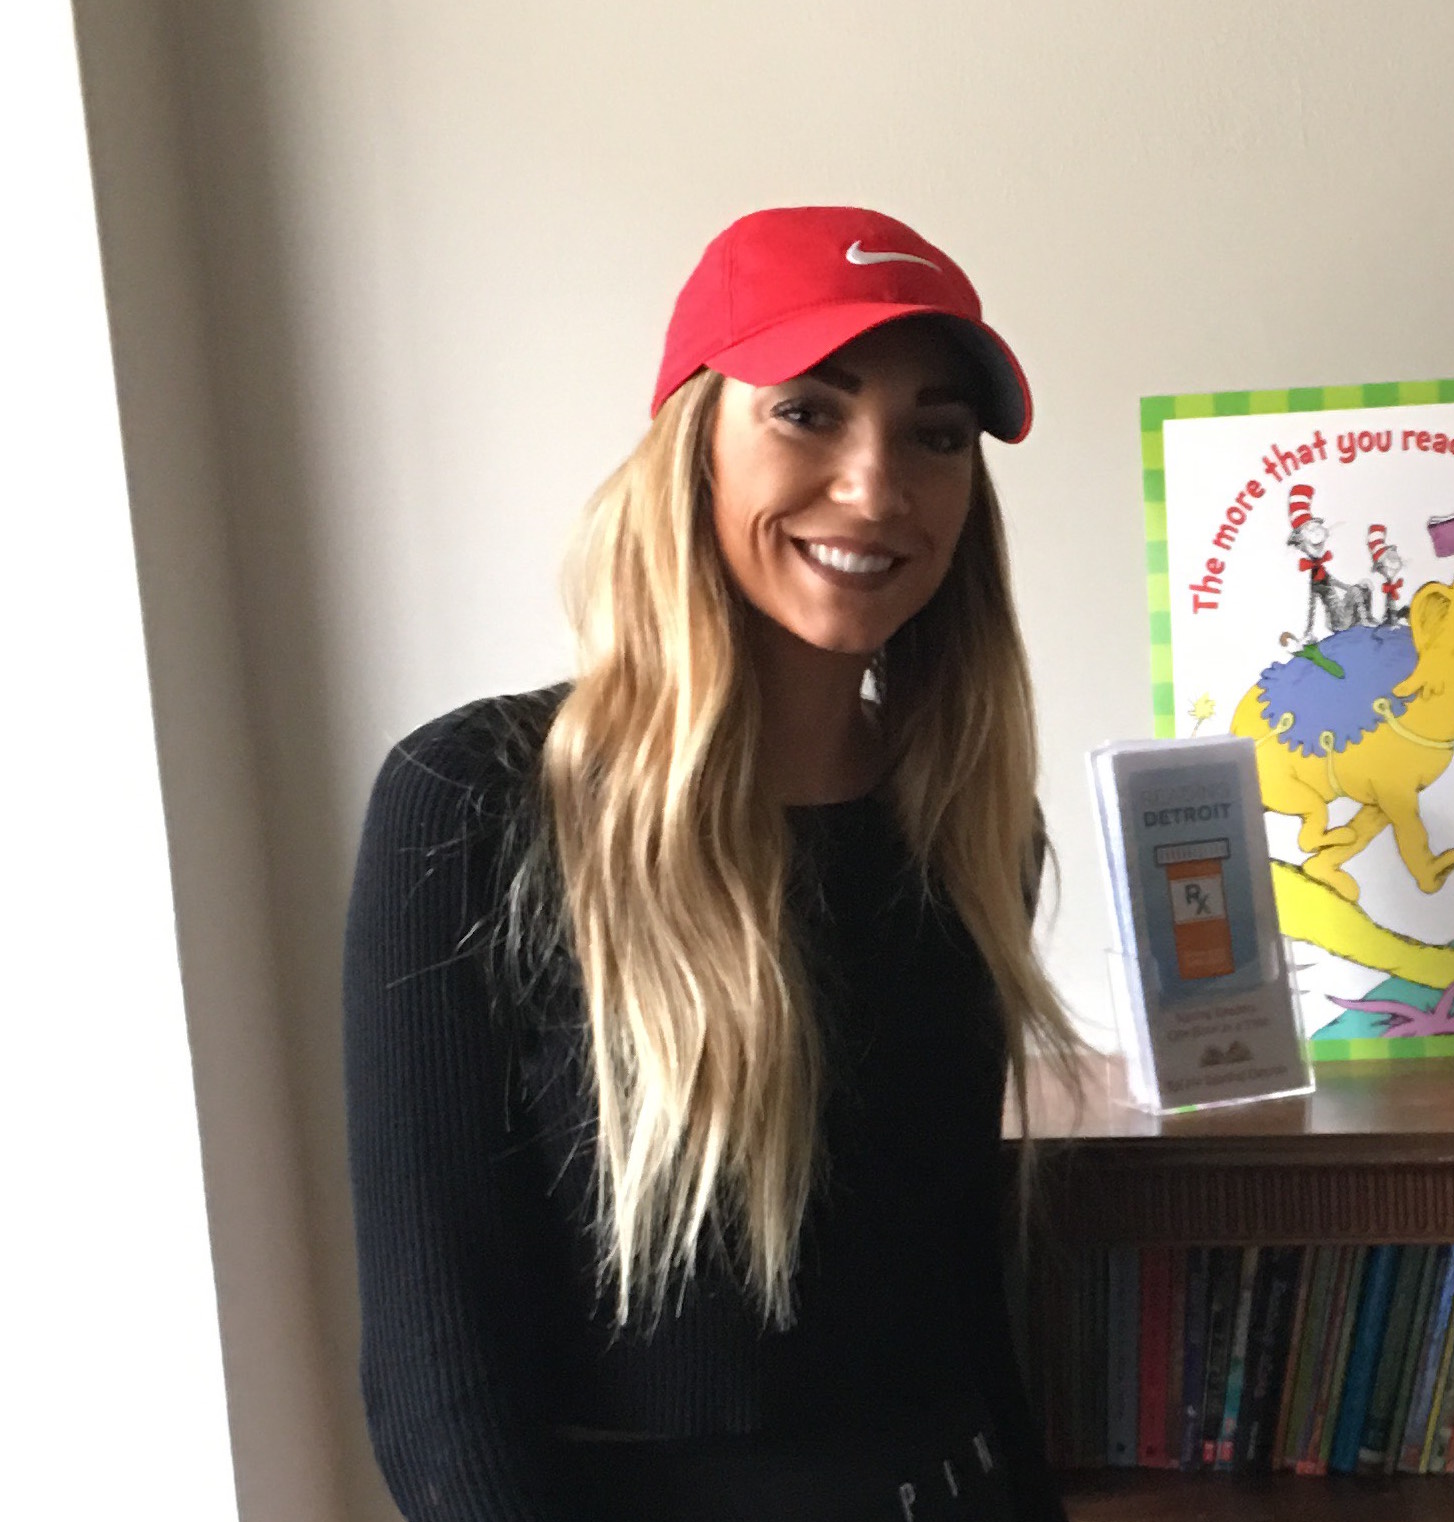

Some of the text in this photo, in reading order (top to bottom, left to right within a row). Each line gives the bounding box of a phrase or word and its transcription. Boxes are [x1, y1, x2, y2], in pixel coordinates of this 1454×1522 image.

[1189, 557, 1225, 614] The
[1213, 480, 1266, 550] more
[1263, 430, 1328, 482] that
[1337, 430, 1392, 463] you
[1143, 803, 1231, 827] DETROIT
